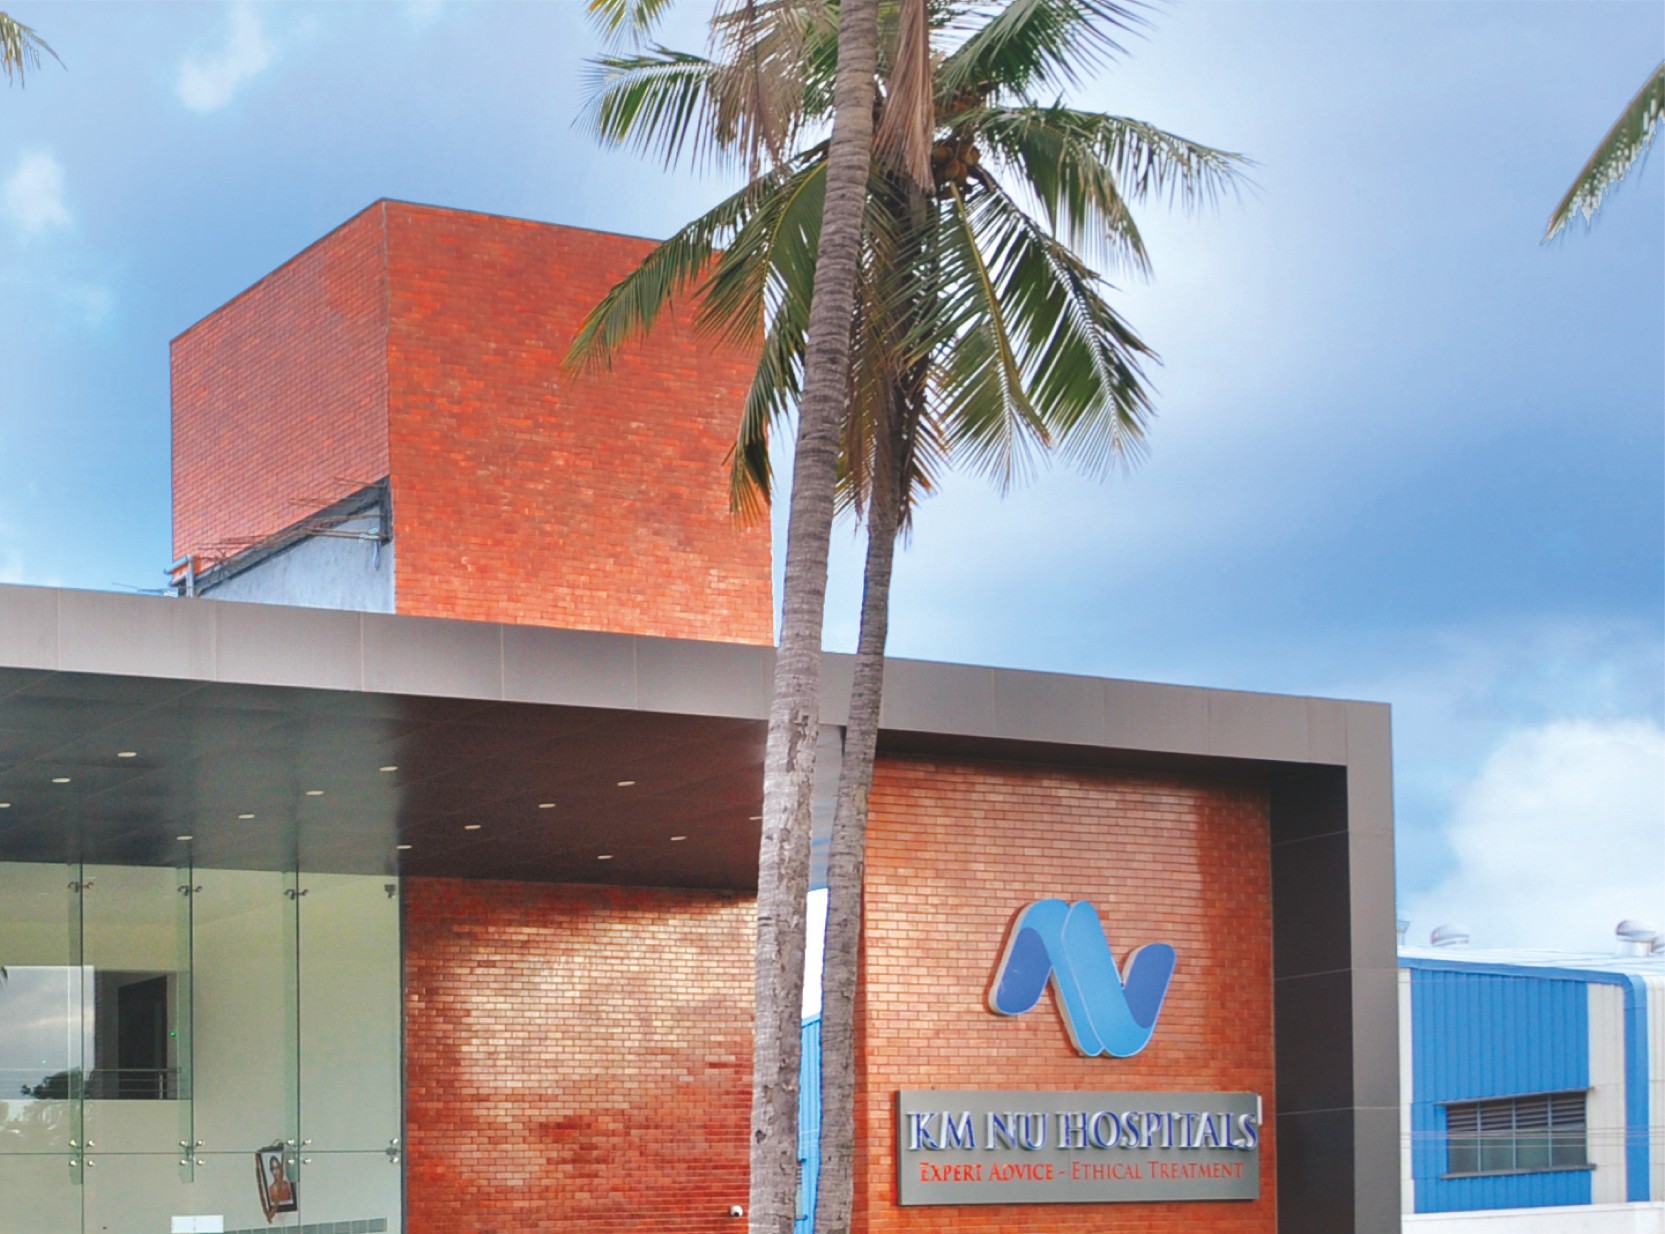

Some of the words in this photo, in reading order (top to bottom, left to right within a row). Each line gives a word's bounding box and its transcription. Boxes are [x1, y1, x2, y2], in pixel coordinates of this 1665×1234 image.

[906, 1111, 976, 1151] KM
[985, 1111, 1048, 1150] NU
[1056, 1111, 1258, 1150] HOSPITALS
[919, 1162, 983, 1182] EXPERT
[989, 1162, 1054, 1181] ADVICE
[1072, 1161, 1142, 1180] ETHICAL
[1148, 1161, 1245, 1180] TREATMENT
